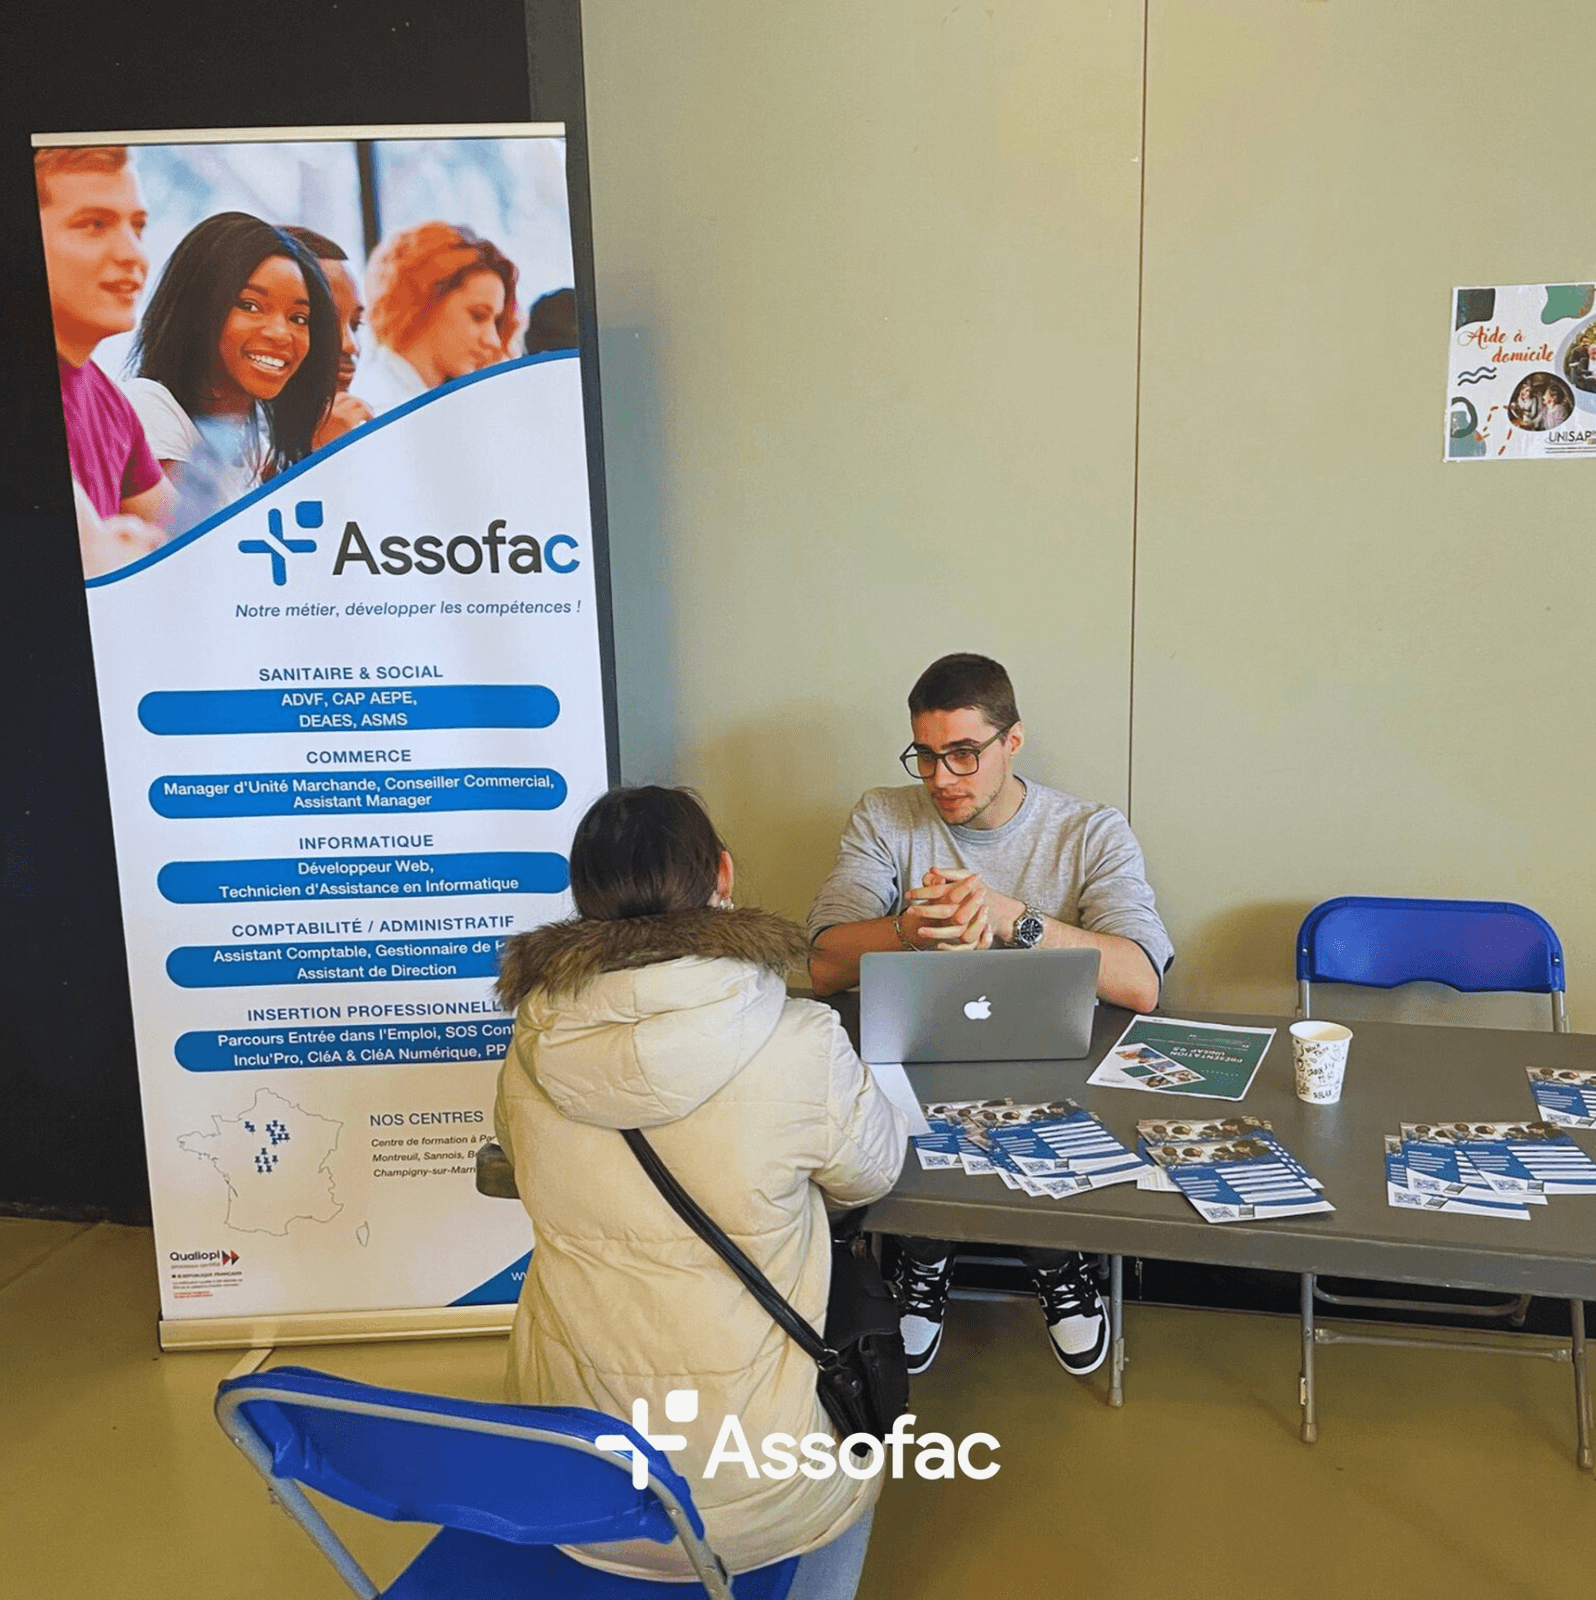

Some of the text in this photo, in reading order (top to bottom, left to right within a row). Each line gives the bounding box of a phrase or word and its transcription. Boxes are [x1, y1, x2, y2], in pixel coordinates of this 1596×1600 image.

[1458, 325, 1525, 350] Aide à
[1491, 343, 1555, 363] domicile
[1548, 430, 1592, 442] UNISAP
[332, 519, 580, 576] Assofac
[235, 599, 582, 619] Notre métier, développer les compétences !
[258, 665, 444, 682] SANITAIRE & SOCIAL
[281, 691, 418, 709] ADVF, CAP AEPE,
[299, 713, 408, 730] DEAES, ASMS
[306, 749, 412, 764] COMMERCE
[164, 773, 555, 799] Manager d'Unité Marchande, Conseiller Commercial,
[293, 793, 432, 811] Assistant Manager
[299, 835, 434, 850] INFORMATIQUE
[298, 859, 434, 879] Développeur Web,
[219, 876, 519, 899] Technicien d'Assistance en Informatique
[232, 915, 515, 937] COMPTABILITÉ / ADMINISTRATIF
[213, 948, 283, 963] Assistant
[286, 945, 373, 962] Comptable,
[375, 942, 469, 958] Gestionnaire
[472, 941, 491, 955] de
[297, 962, 457, 980] Assistant de Direction
[247, 1006, 341, 1022] INSERTION
[218, 1032, 285, 1048] Parcours
[288, 1029, 336, 1045] Entrée
[339, 1028, 376, 1043] dans
[379, 1026, 442, 1043] l'Emploi,
[445, 1025, 478, 1040] SOS
[234, 1049, 304, 1066] Inclu'Pro,
[307, 1047, 342, 1063] CléA
[346, 1048, 356, 1061] &
[360, 1045, 395, 1061] CléA
[398, 1043, 483, 1061] Numérique,
[370, 1110, 484, 1127] NOS CENTRES
[371, 1138, 404, 1148] Centre
[406, 1138, 419, 1146] de
[421, 1136, 468, 1146] formation
[470, 1135, 477, 1144] à
[372, 1152, 421, 1163] Montreuil,
[423, 1151, 465, 1161] Sannois,
[373, 1165, 476, 1178] Champigny-sur-Marn
[169, 1249, 220, 1261] Qualiopi
